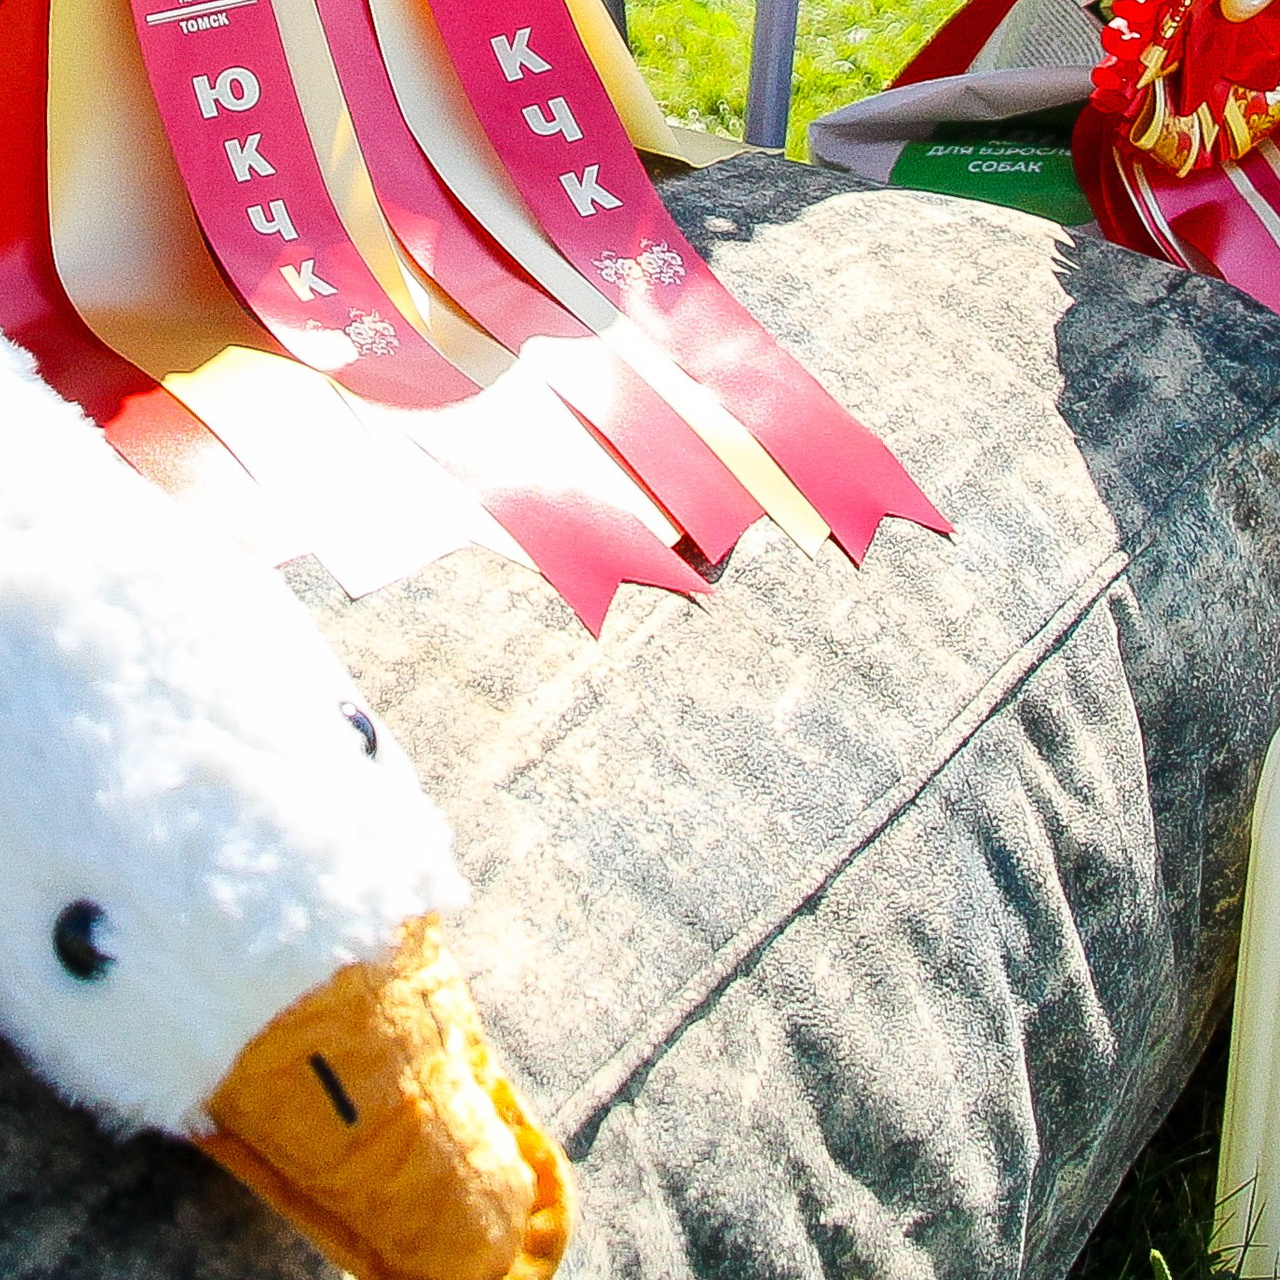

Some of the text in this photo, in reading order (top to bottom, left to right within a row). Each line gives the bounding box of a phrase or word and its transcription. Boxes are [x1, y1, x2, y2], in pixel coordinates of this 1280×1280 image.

[179, 12, 230, 34] ТОМСК
[925, 145, 1073, 156] ДЛЯ ВЗРОСЛЫ
[968, 160, 1043, 173] СОБАК
